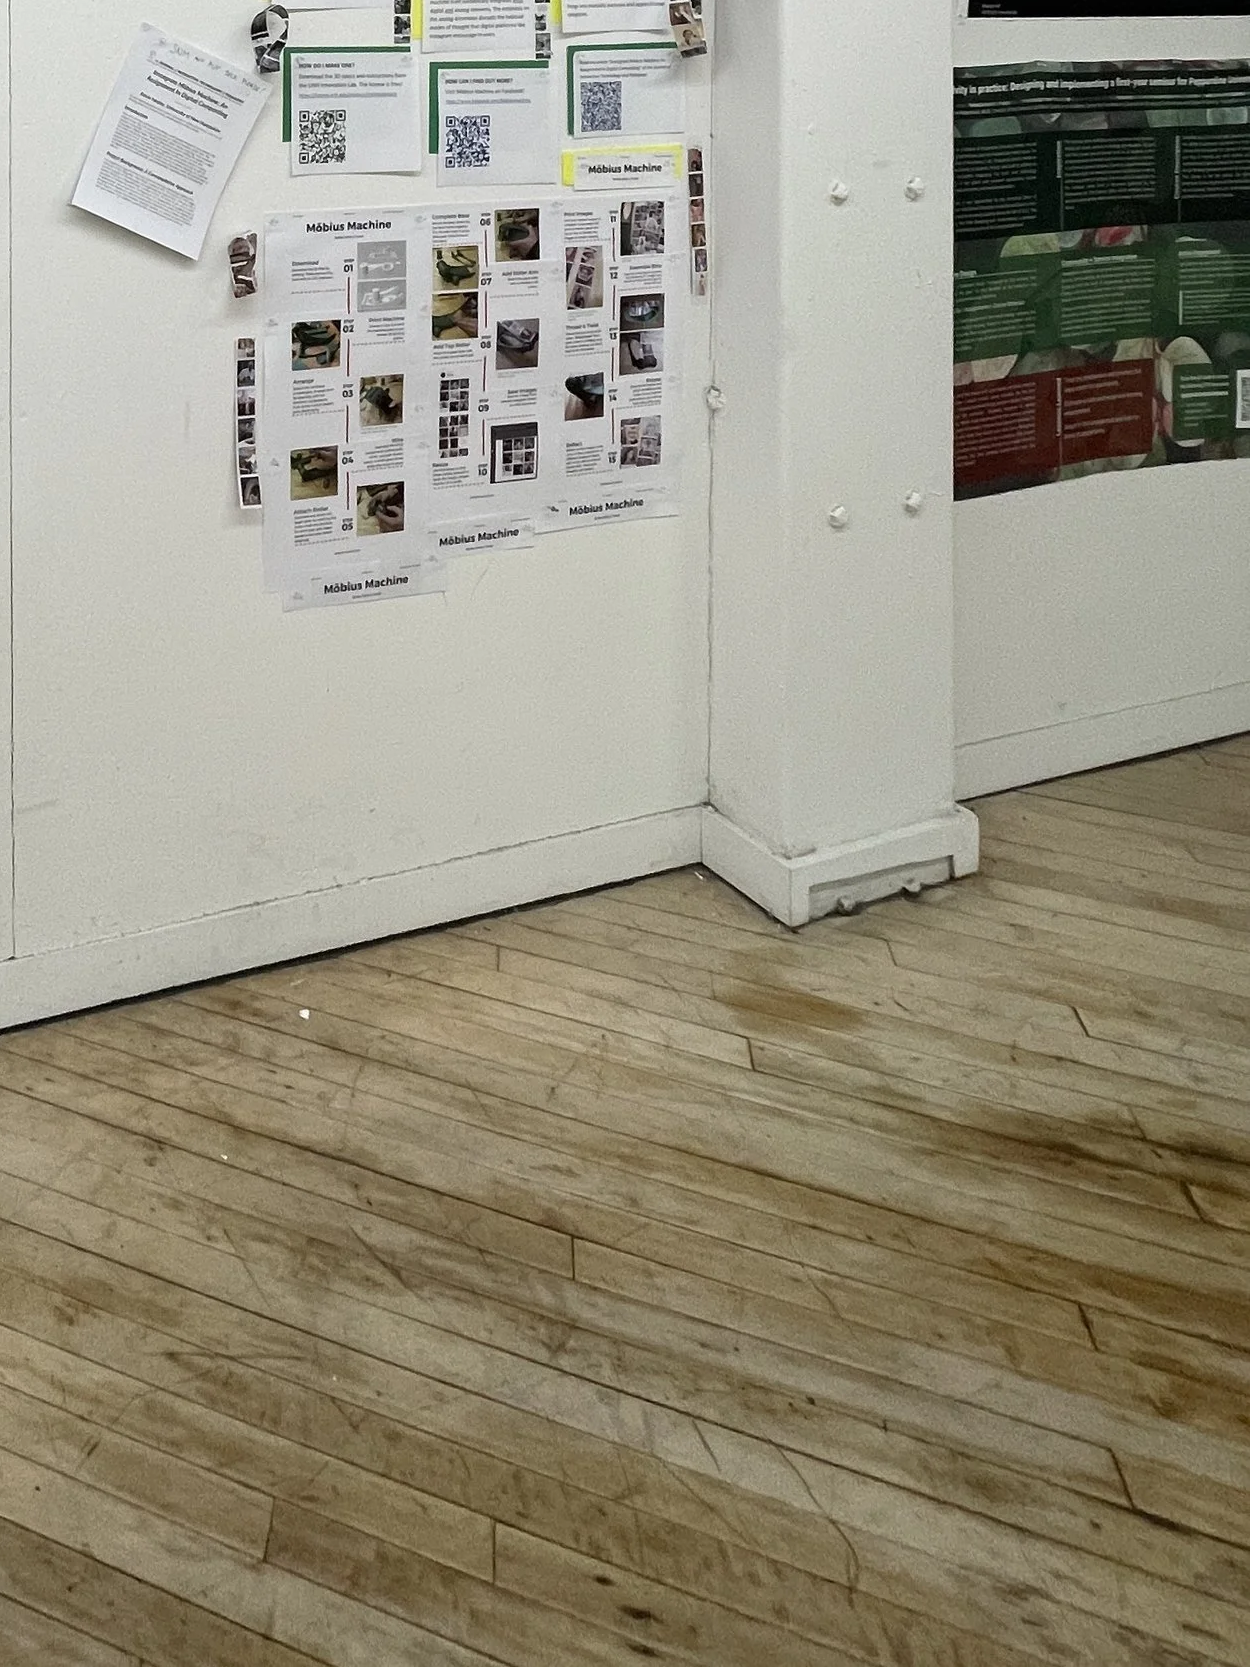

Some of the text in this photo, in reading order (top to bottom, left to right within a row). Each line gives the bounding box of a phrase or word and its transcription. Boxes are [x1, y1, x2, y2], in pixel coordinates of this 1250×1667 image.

[588, 163, 662, 174] Möbius Machine
[480, 218, 491, 226] 06
[306, 220, 392, 233] Möbius Machine
[343, 264, 354, 273] 01
[480, 277, 492, 286] 07
[342, 325, 354, 333] 02
[609, 332, 617, 340] 13
[480, 341, 492, 349] 08
[342, 389, 354, 398] 03
[478, 404, 490, 412] 09
[341, 457, 354, 465] 04
[478, 468, 488, 476] 10
[569, 498, 644, 516] Möbius Machine
[341, 523, 354, 531] 05
[439, 528, 520, 547] Möbius Machine
[324, 575, 409, 594] Möbius Machine
